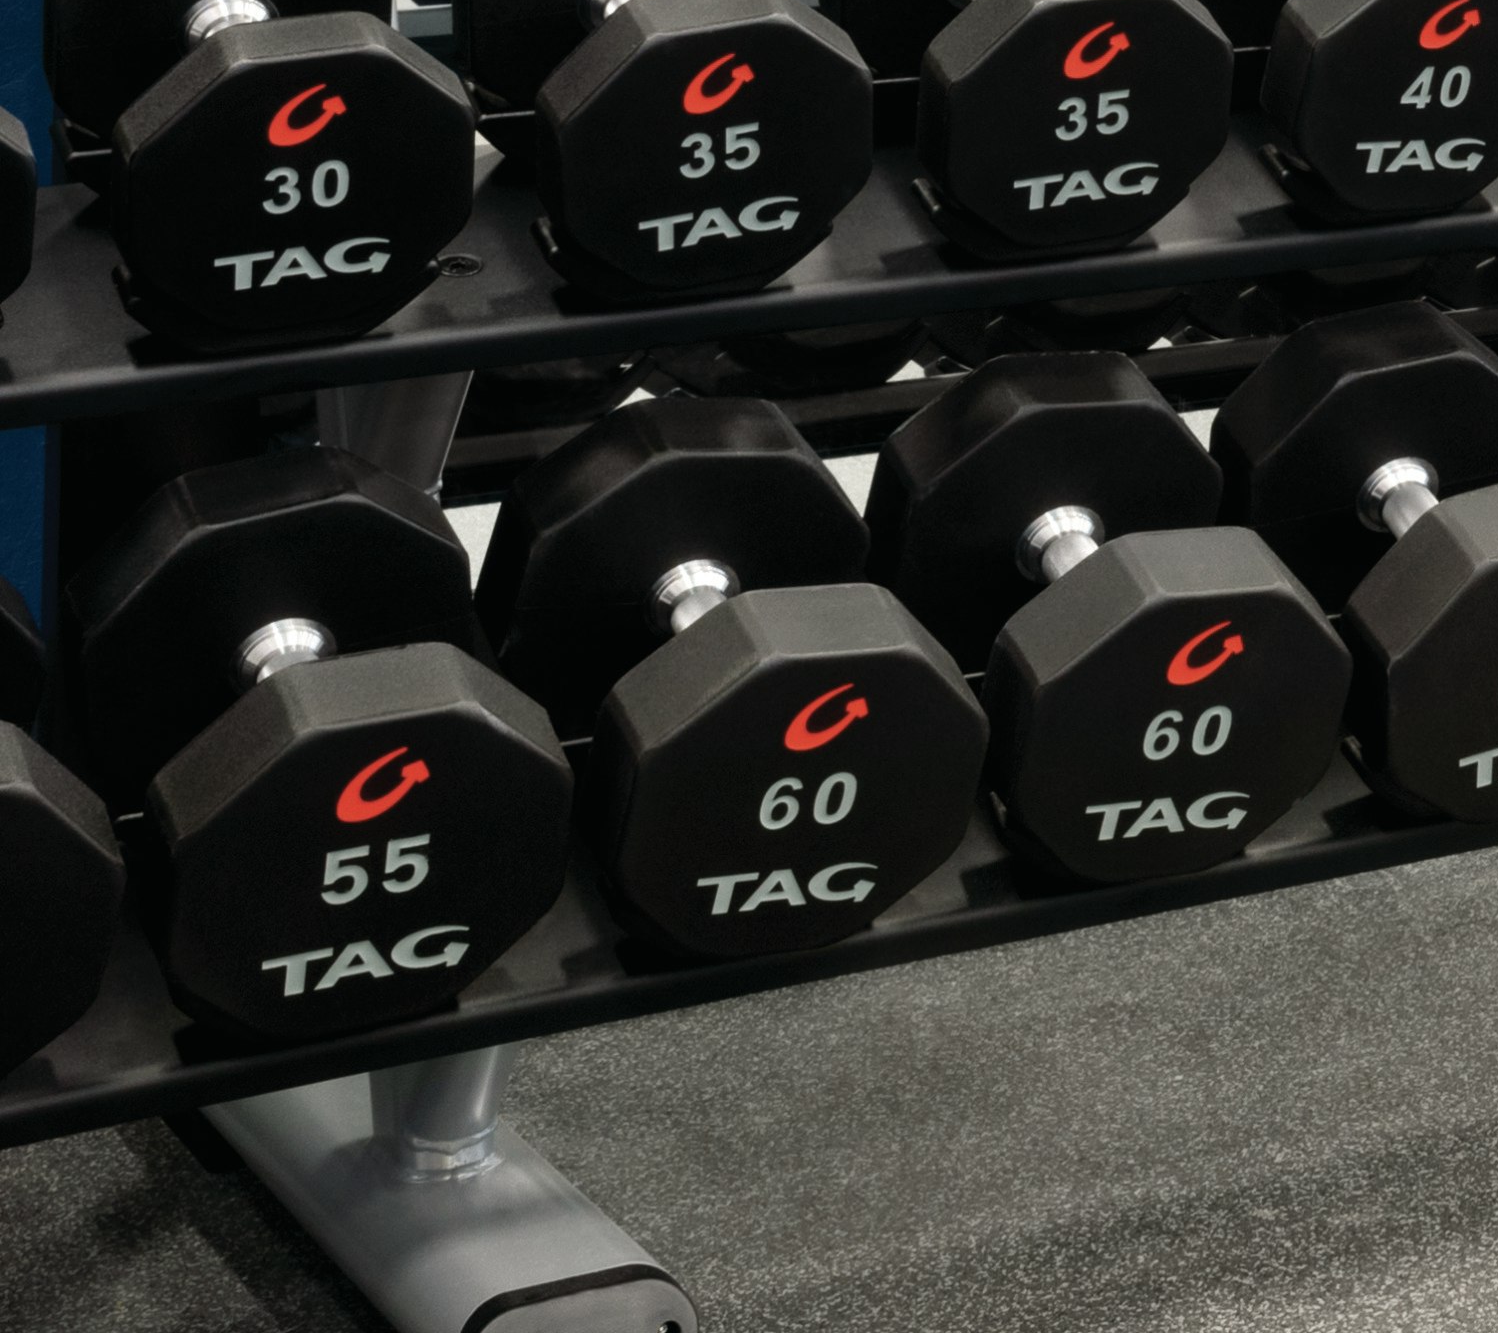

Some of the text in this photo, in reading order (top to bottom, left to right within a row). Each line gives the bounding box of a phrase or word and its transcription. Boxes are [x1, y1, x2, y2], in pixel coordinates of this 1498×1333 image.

[1399, 65, 1471, 110] 40
[1054, 89, 1130, 142] 35
[679, 122, 761, 179] 35
[1355, 137, 1486, 174] TAG
[262, 159, 350, 215] 30
[1013, 162, 1159, 211] TAG
[638, 196, 800, 252] TAG
[213, 236, 391, 291] TAG
[1142, 705, 1233, 761] 60
[759, 771, 858, 831] 60
[1085, 791, 1250, 841] TAG
[320, 833, 431, 906] 55
[696, 862, 878, 916] TAG
[261, 925, 469, 998] TAG
